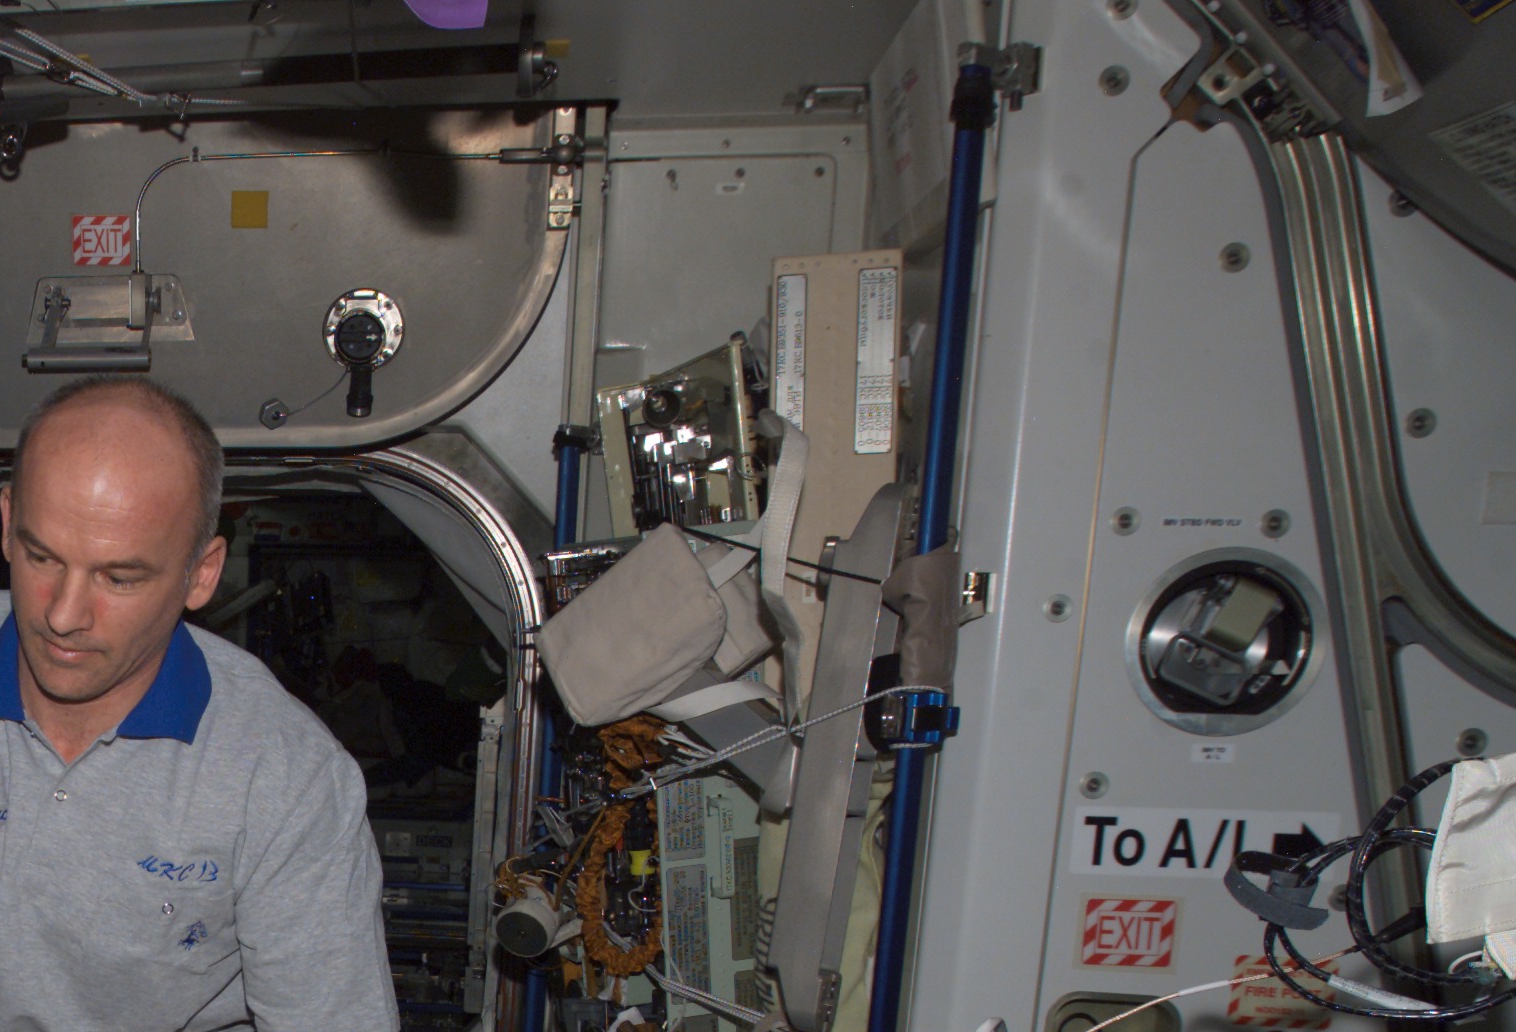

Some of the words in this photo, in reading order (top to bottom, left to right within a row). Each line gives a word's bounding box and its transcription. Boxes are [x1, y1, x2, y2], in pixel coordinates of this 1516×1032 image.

[81, 228, 123, 255] EXIT
[416, 835, 452, 848] DECK
[1085, 816, 1145, 866] To
[1097, 915, 1161, 950] EXIT
[1244, 985, 1276, 998] FIRE
[1281, 987, 1322, 1000] POT
